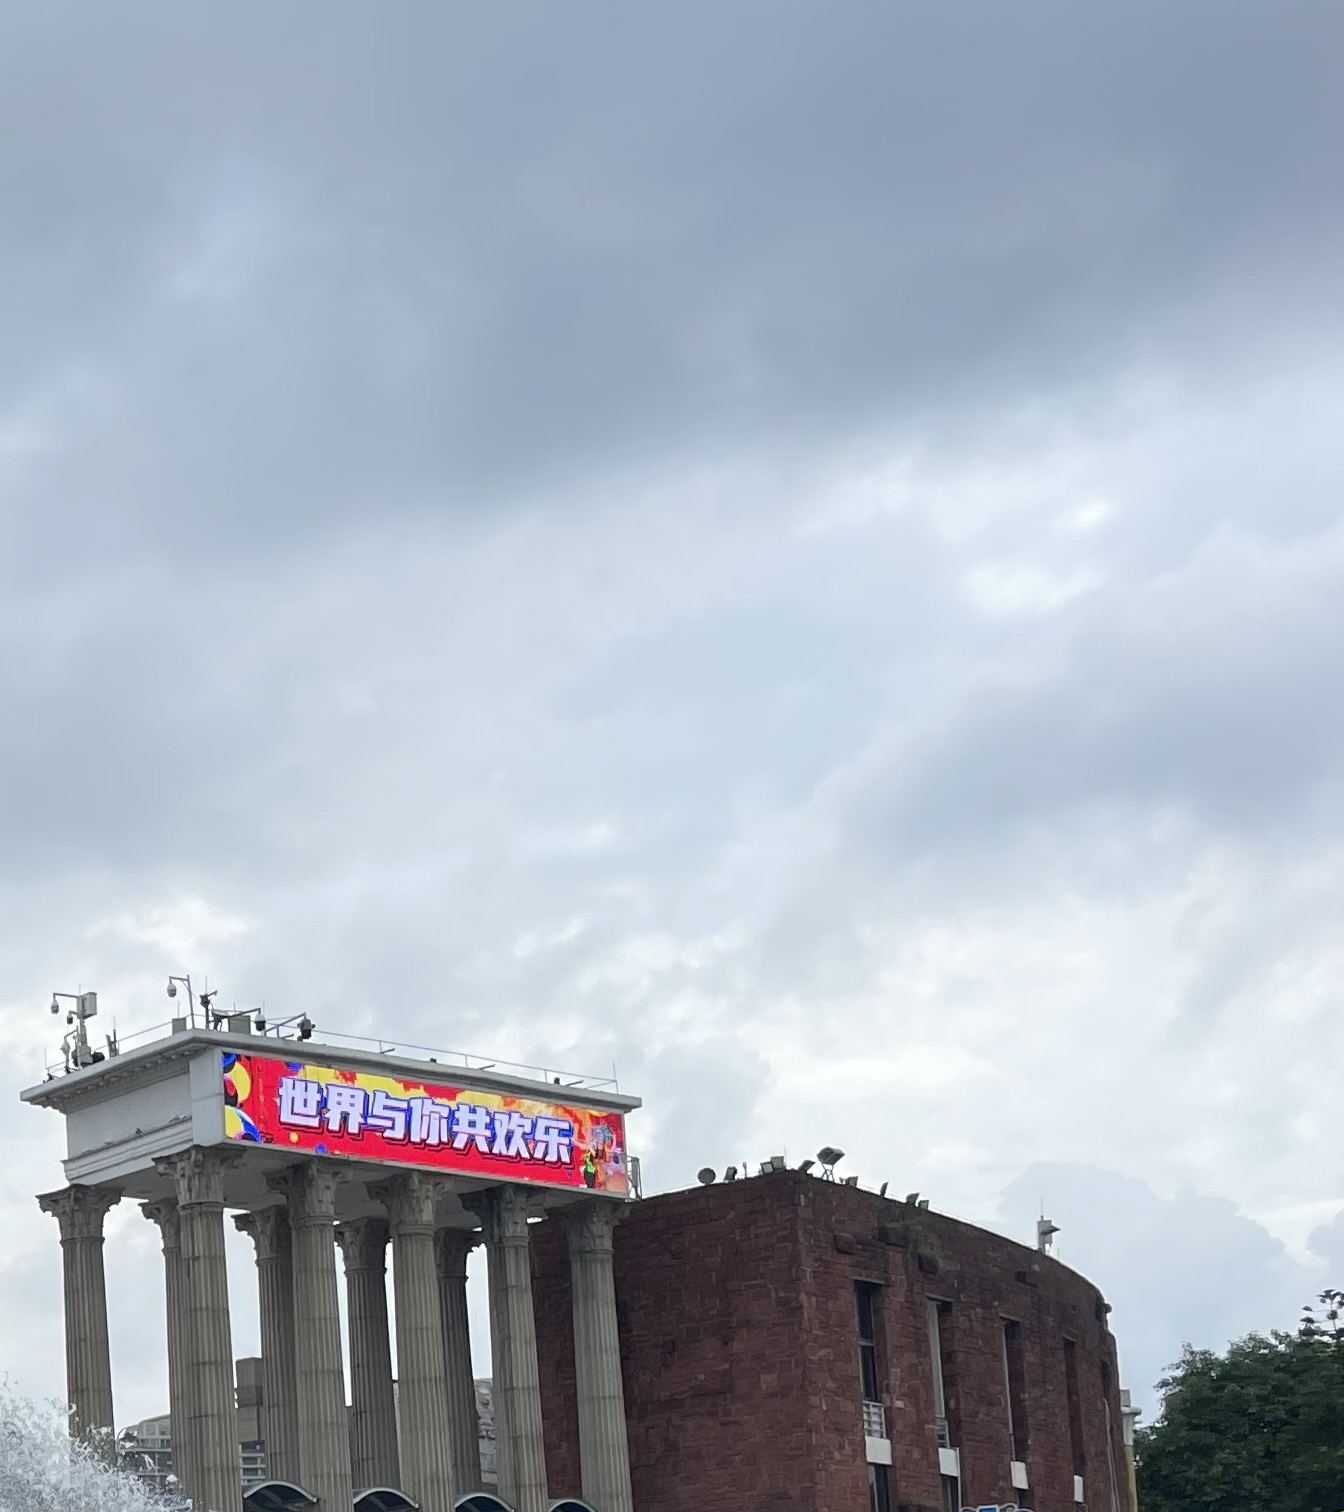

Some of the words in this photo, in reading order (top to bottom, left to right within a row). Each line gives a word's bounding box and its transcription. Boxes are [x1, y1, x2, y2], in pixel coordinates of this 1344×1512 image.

[278, 1075, 574, 1165] 世界与你共欢乐
